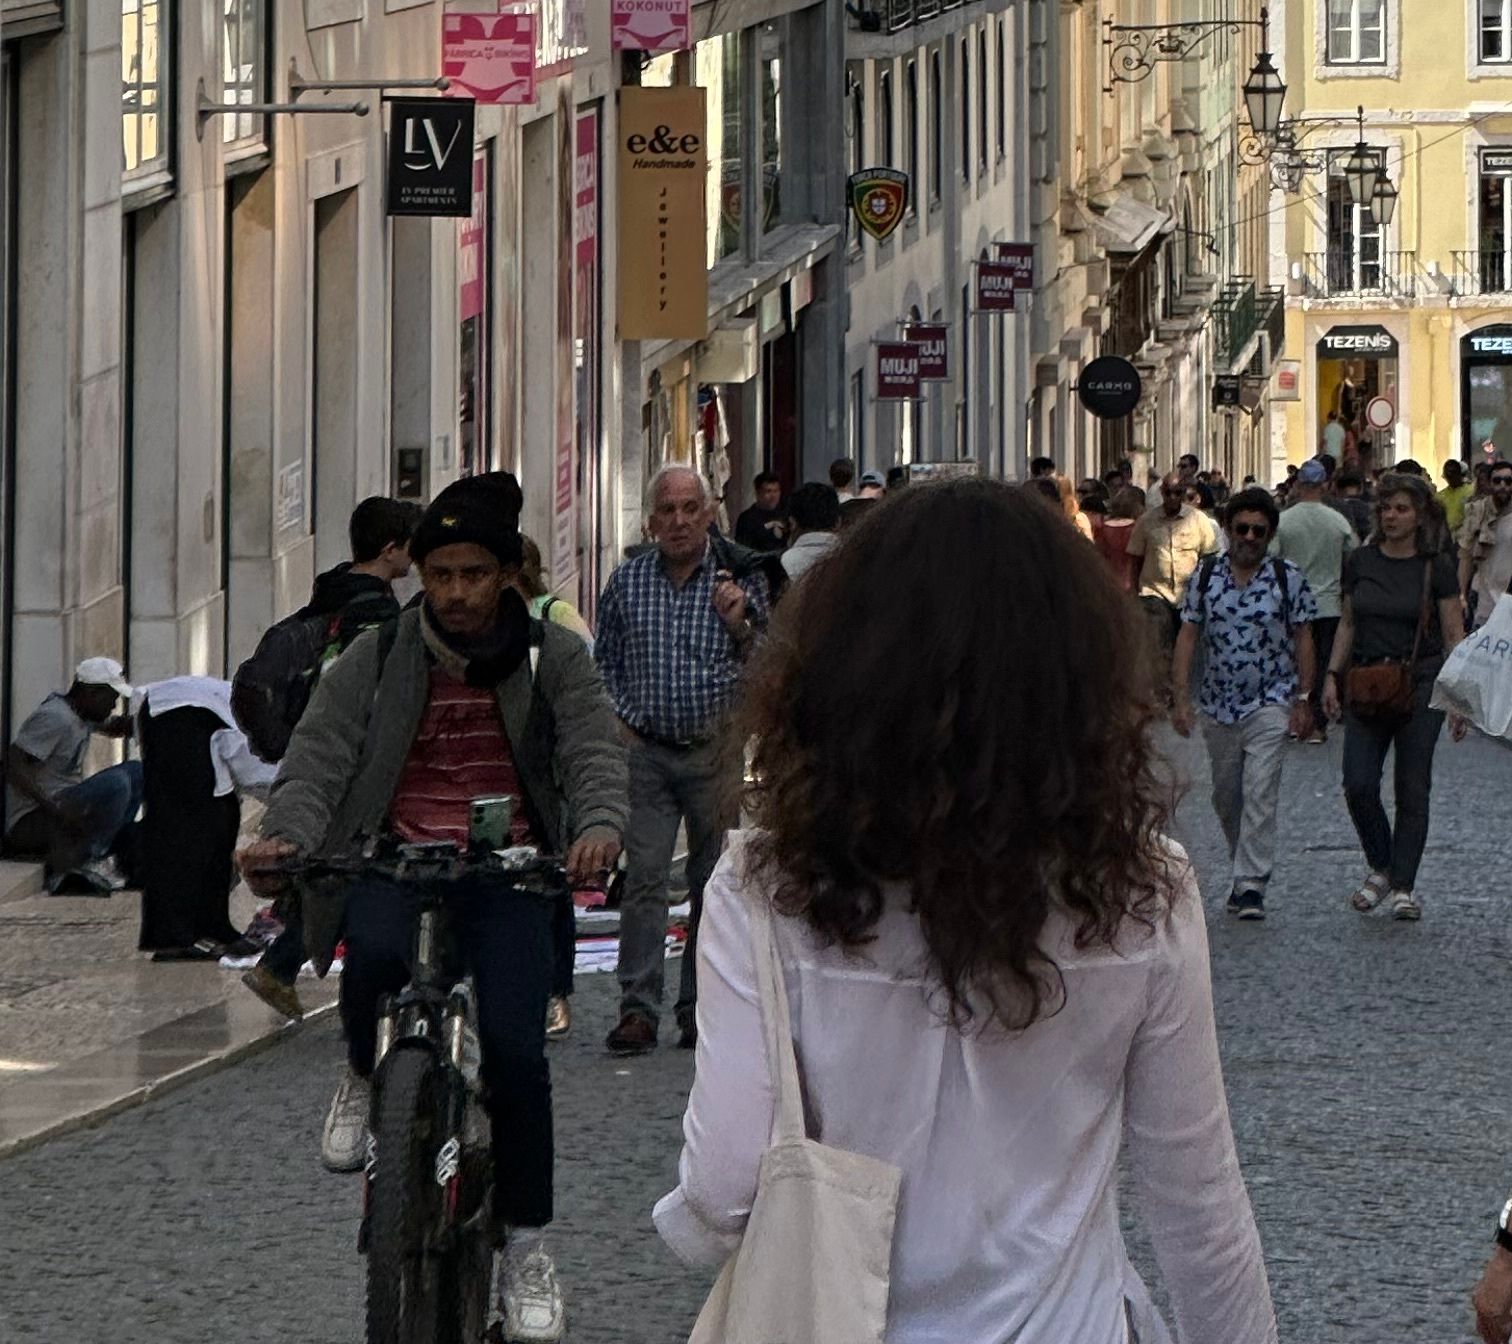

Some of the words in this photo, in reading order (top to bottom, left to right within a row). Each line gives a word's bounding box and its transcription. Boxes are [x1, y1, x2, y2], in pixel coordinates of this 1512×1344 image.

[616, 0, 683, 11] KOKONUT
[404, 118, 462, 170] LV
[626, 124, 700, 154] e&e
[632, 158, 696, 169] Handmade
[980, 275, 1013, 290] MUJI
[1324, 332, 1392, 349] TEZENIS
[880, 358, 918, 375] MUJI
